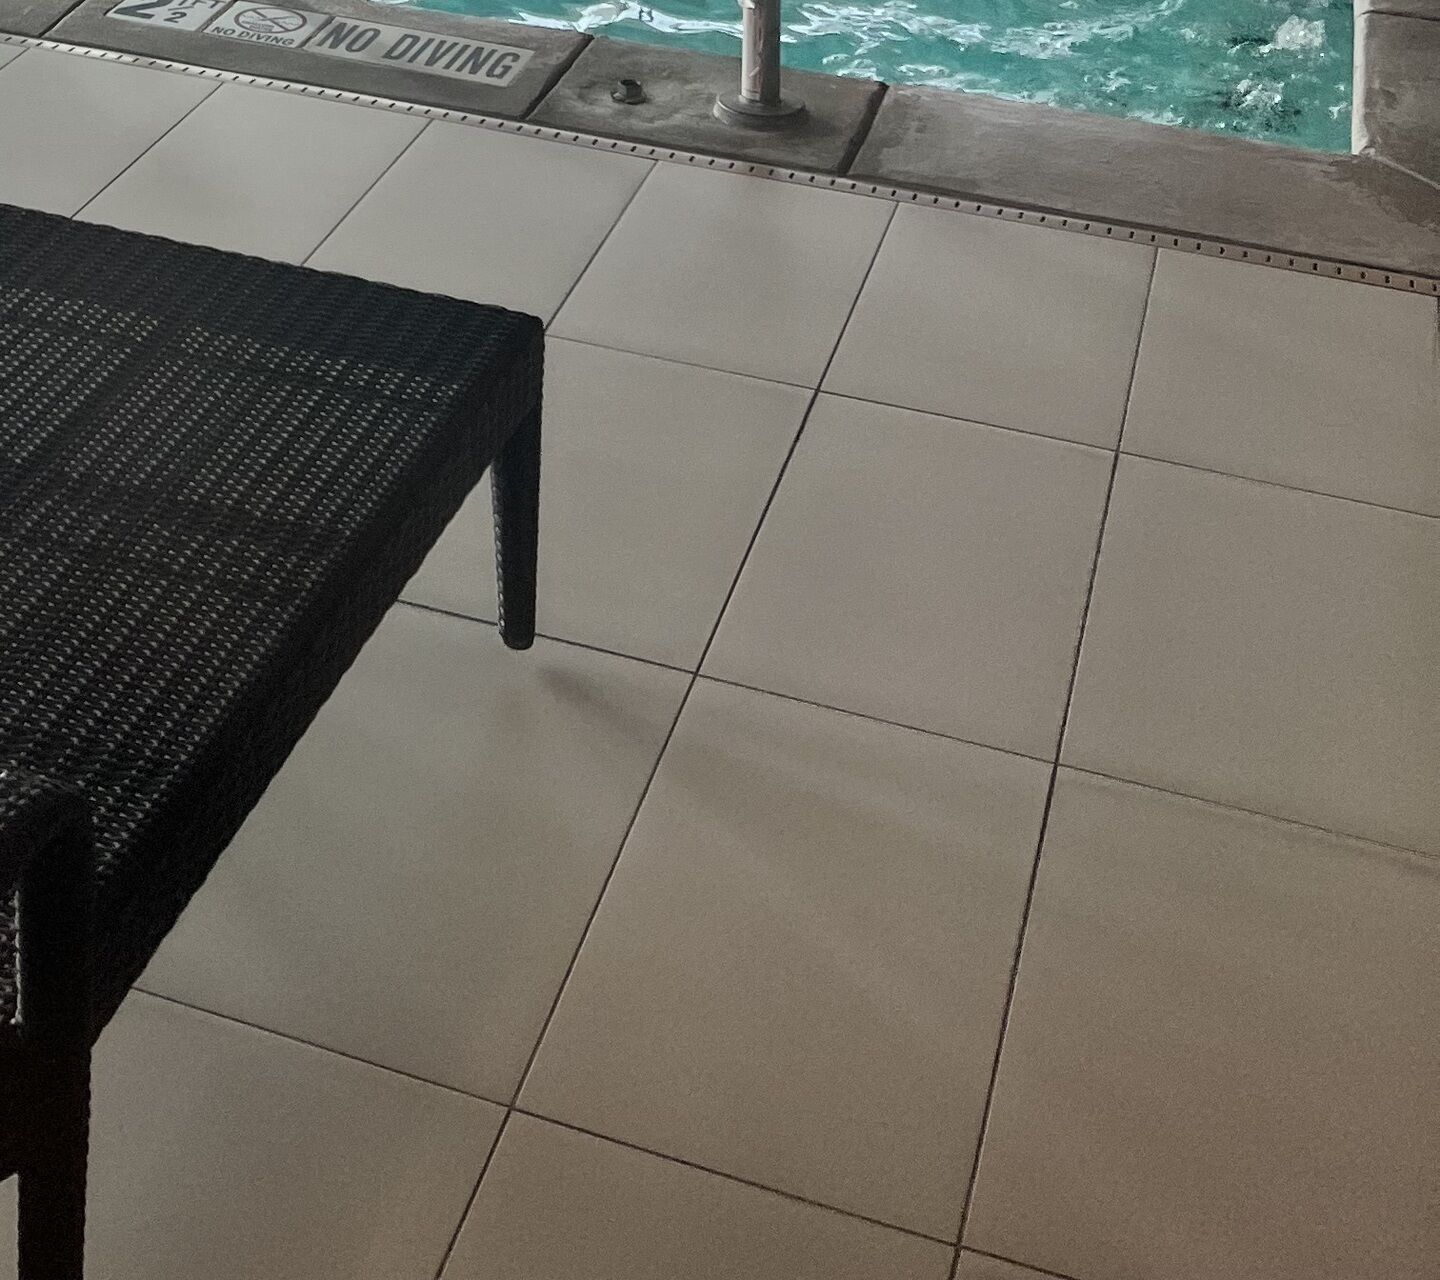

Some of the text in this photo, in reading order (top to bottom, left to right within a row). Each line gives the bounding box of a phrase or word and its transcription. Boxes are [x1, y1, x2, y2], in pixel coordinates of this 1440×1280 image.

[212, 26, 236, 36] NO
[236, 30, 296, 46] DIVING
[316, 21, 521, 80] NO DIVING
